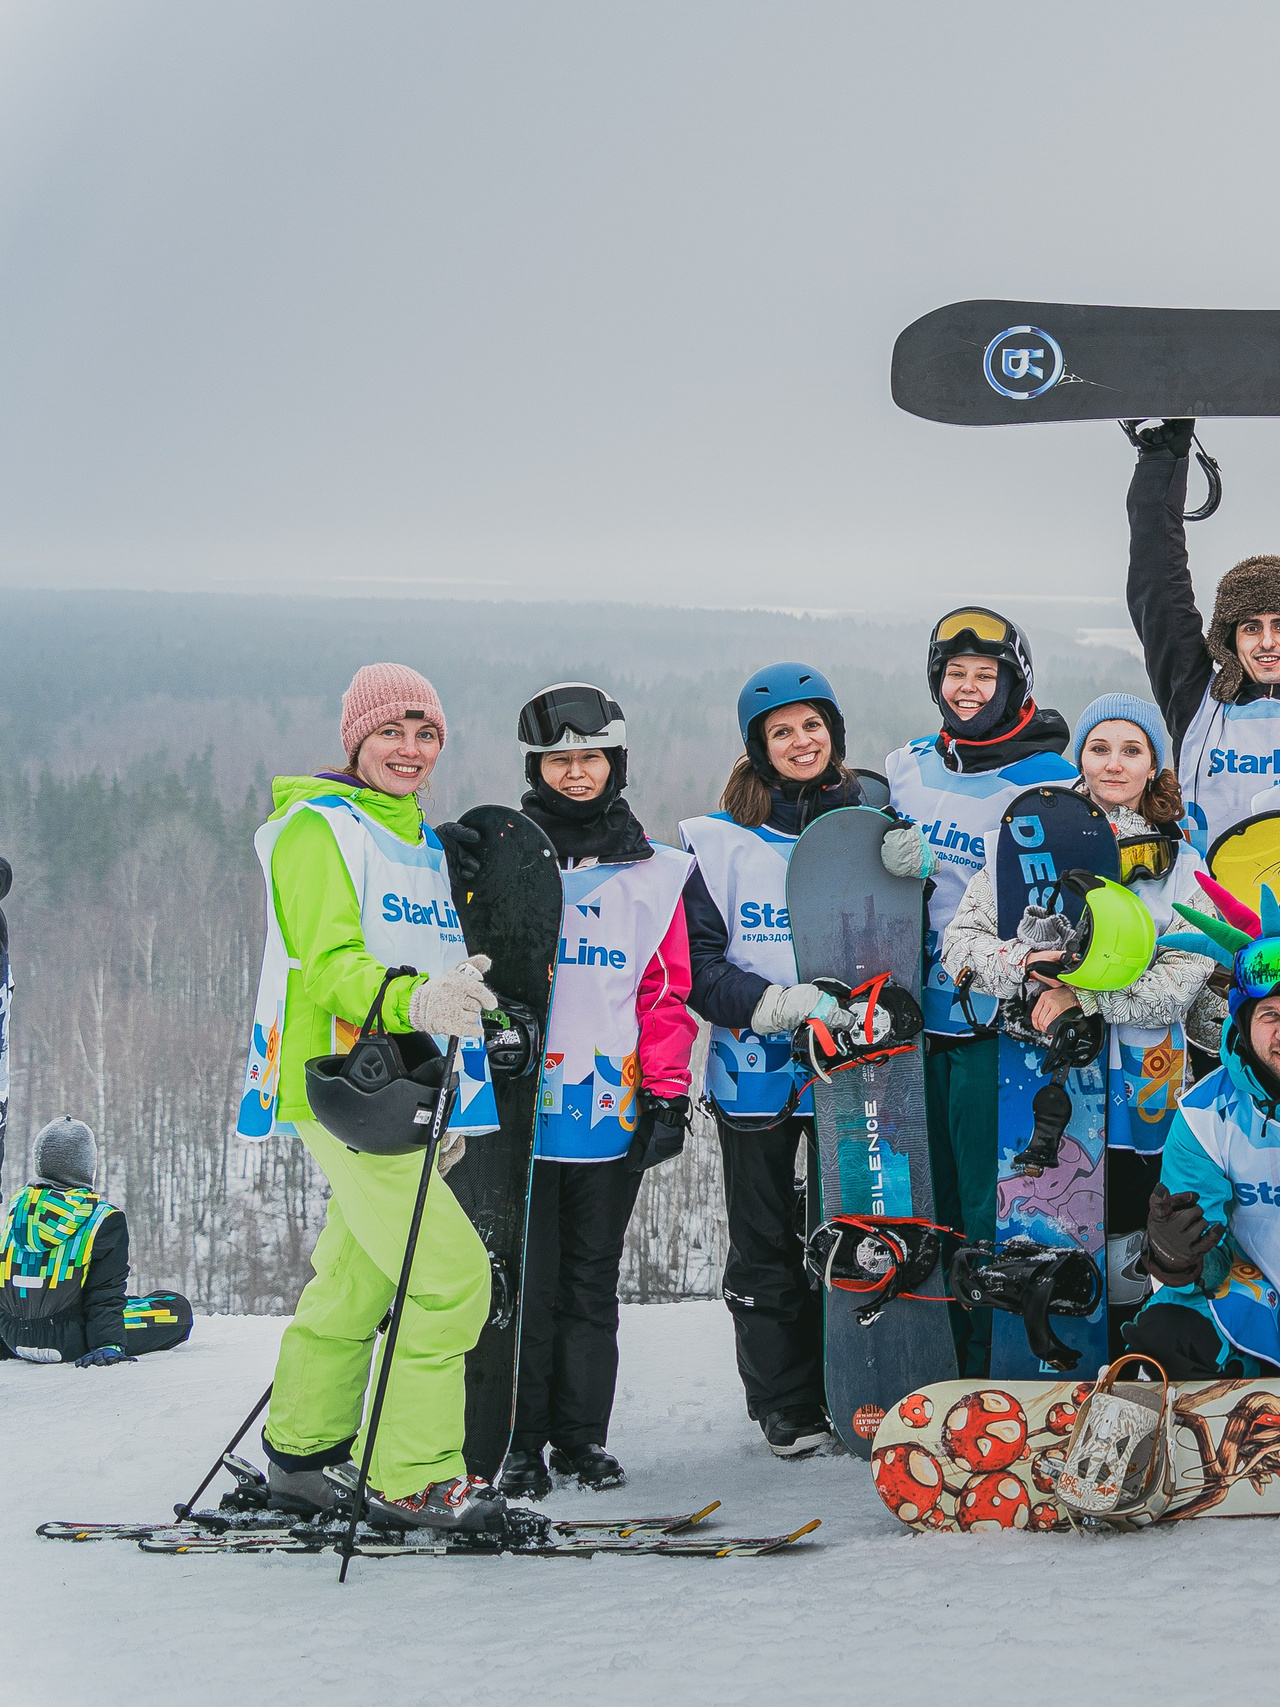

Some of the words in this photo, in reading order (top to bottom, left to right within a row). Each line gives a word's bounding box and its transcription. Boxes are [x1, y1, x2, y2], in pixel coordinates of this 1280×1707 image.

[740, 901, 791, 929] Sta
[558, 937, 627, 970] Line
[432, 1087, 448, 1139] COBER
[864, 1100, 886, 1217] SILENCE
